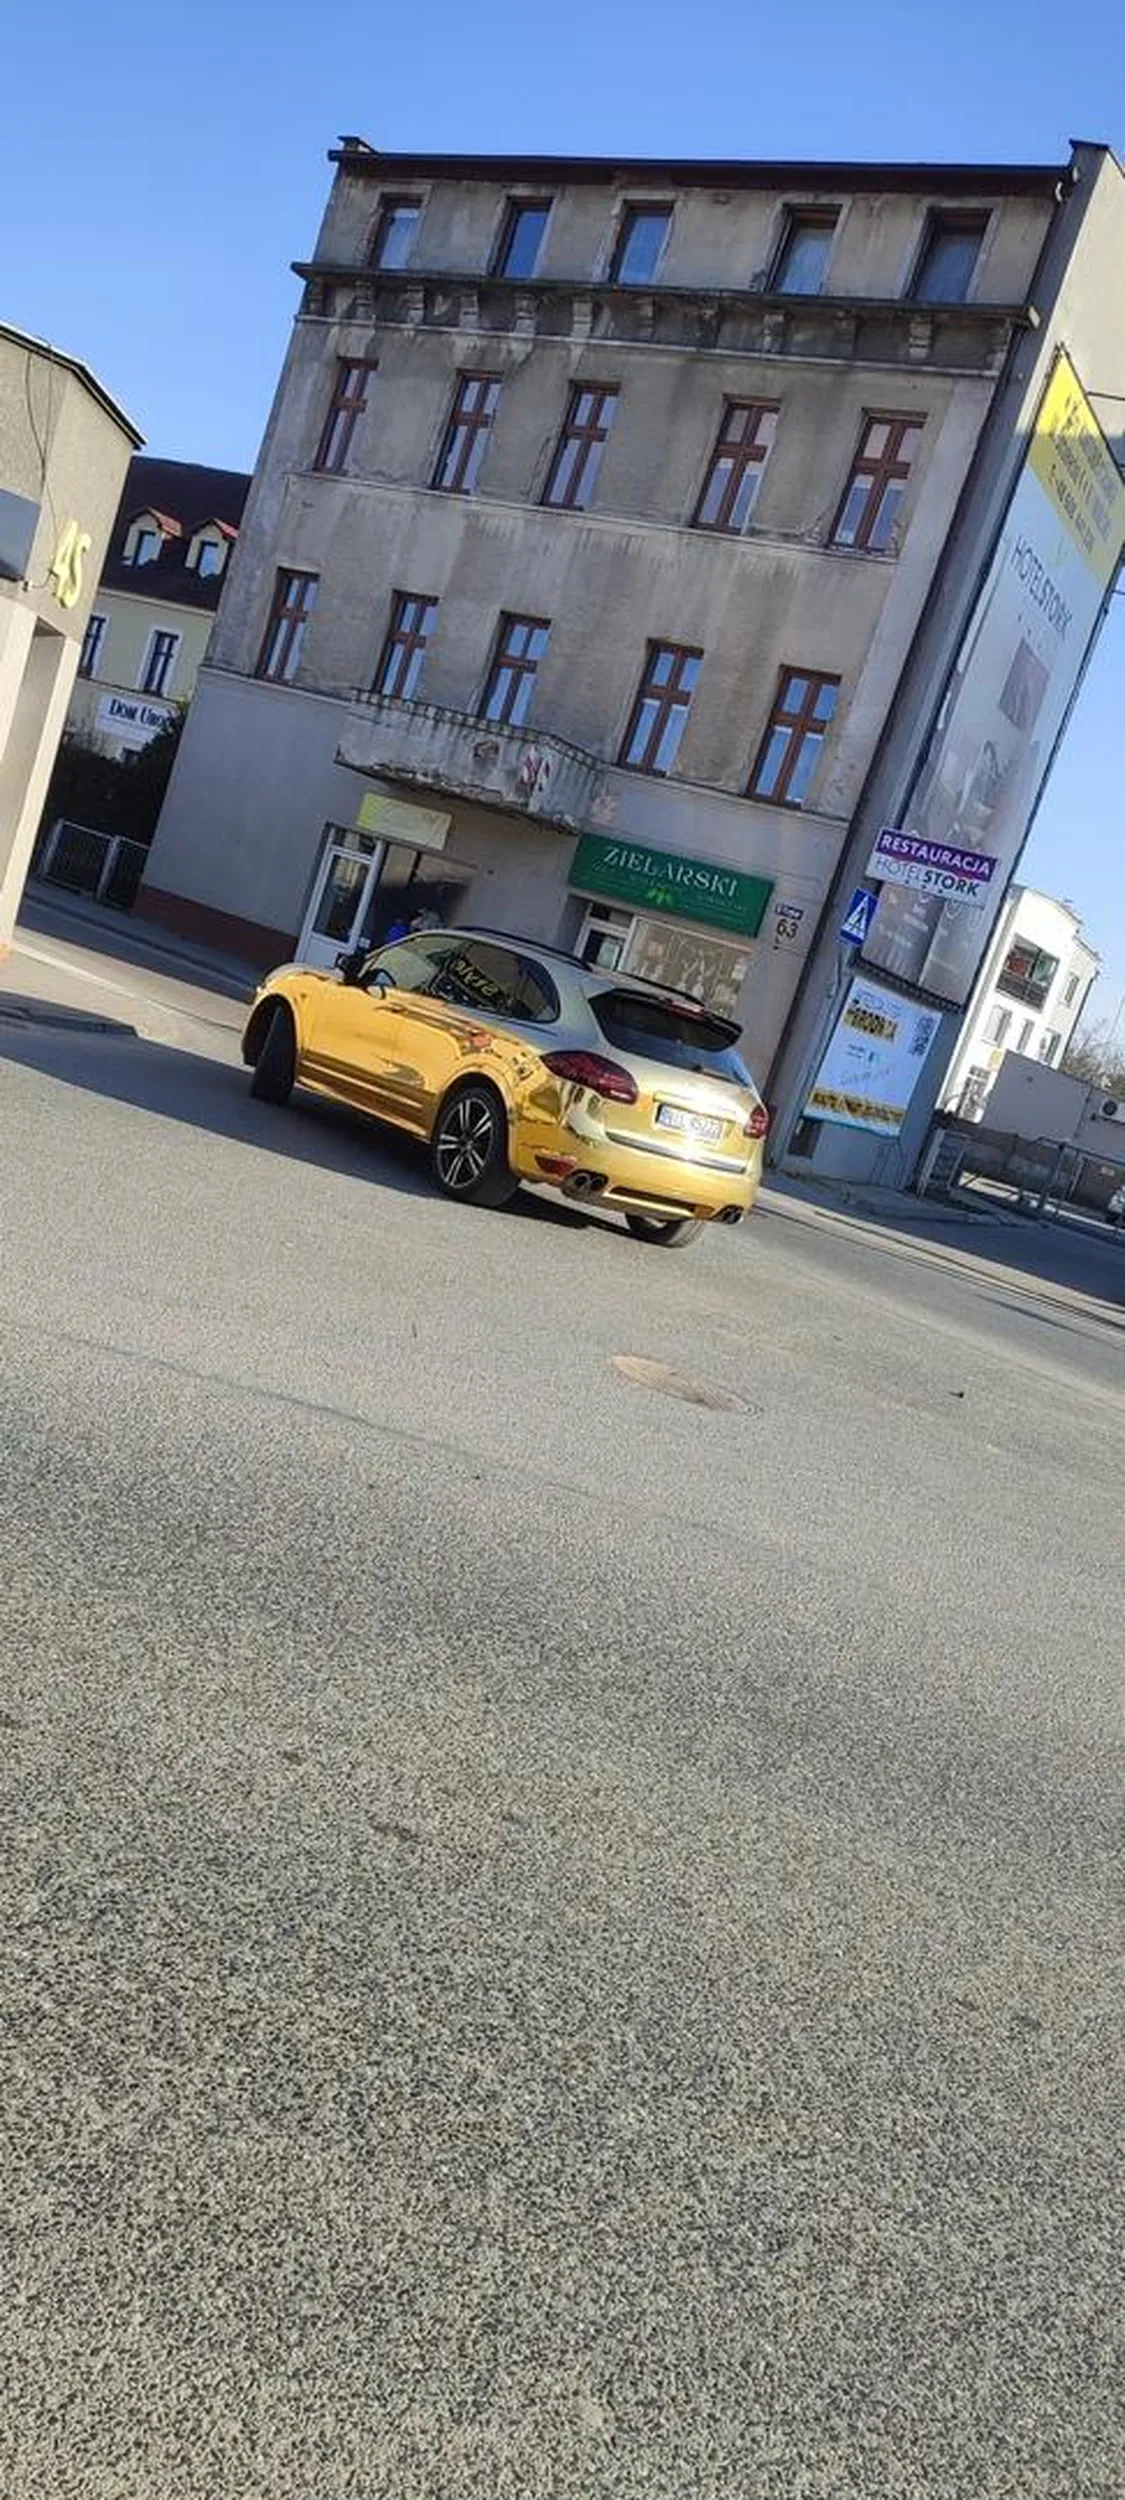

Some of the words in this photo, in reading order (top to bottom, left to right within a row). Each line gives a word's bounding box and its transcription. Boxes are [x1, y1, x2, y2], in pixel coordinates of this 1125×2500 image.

[603, 847, 738, 897] ZIELARSKI
[880, 834, 991, 876] RESTAURACJA
[776, 918, 799, 939] 63
